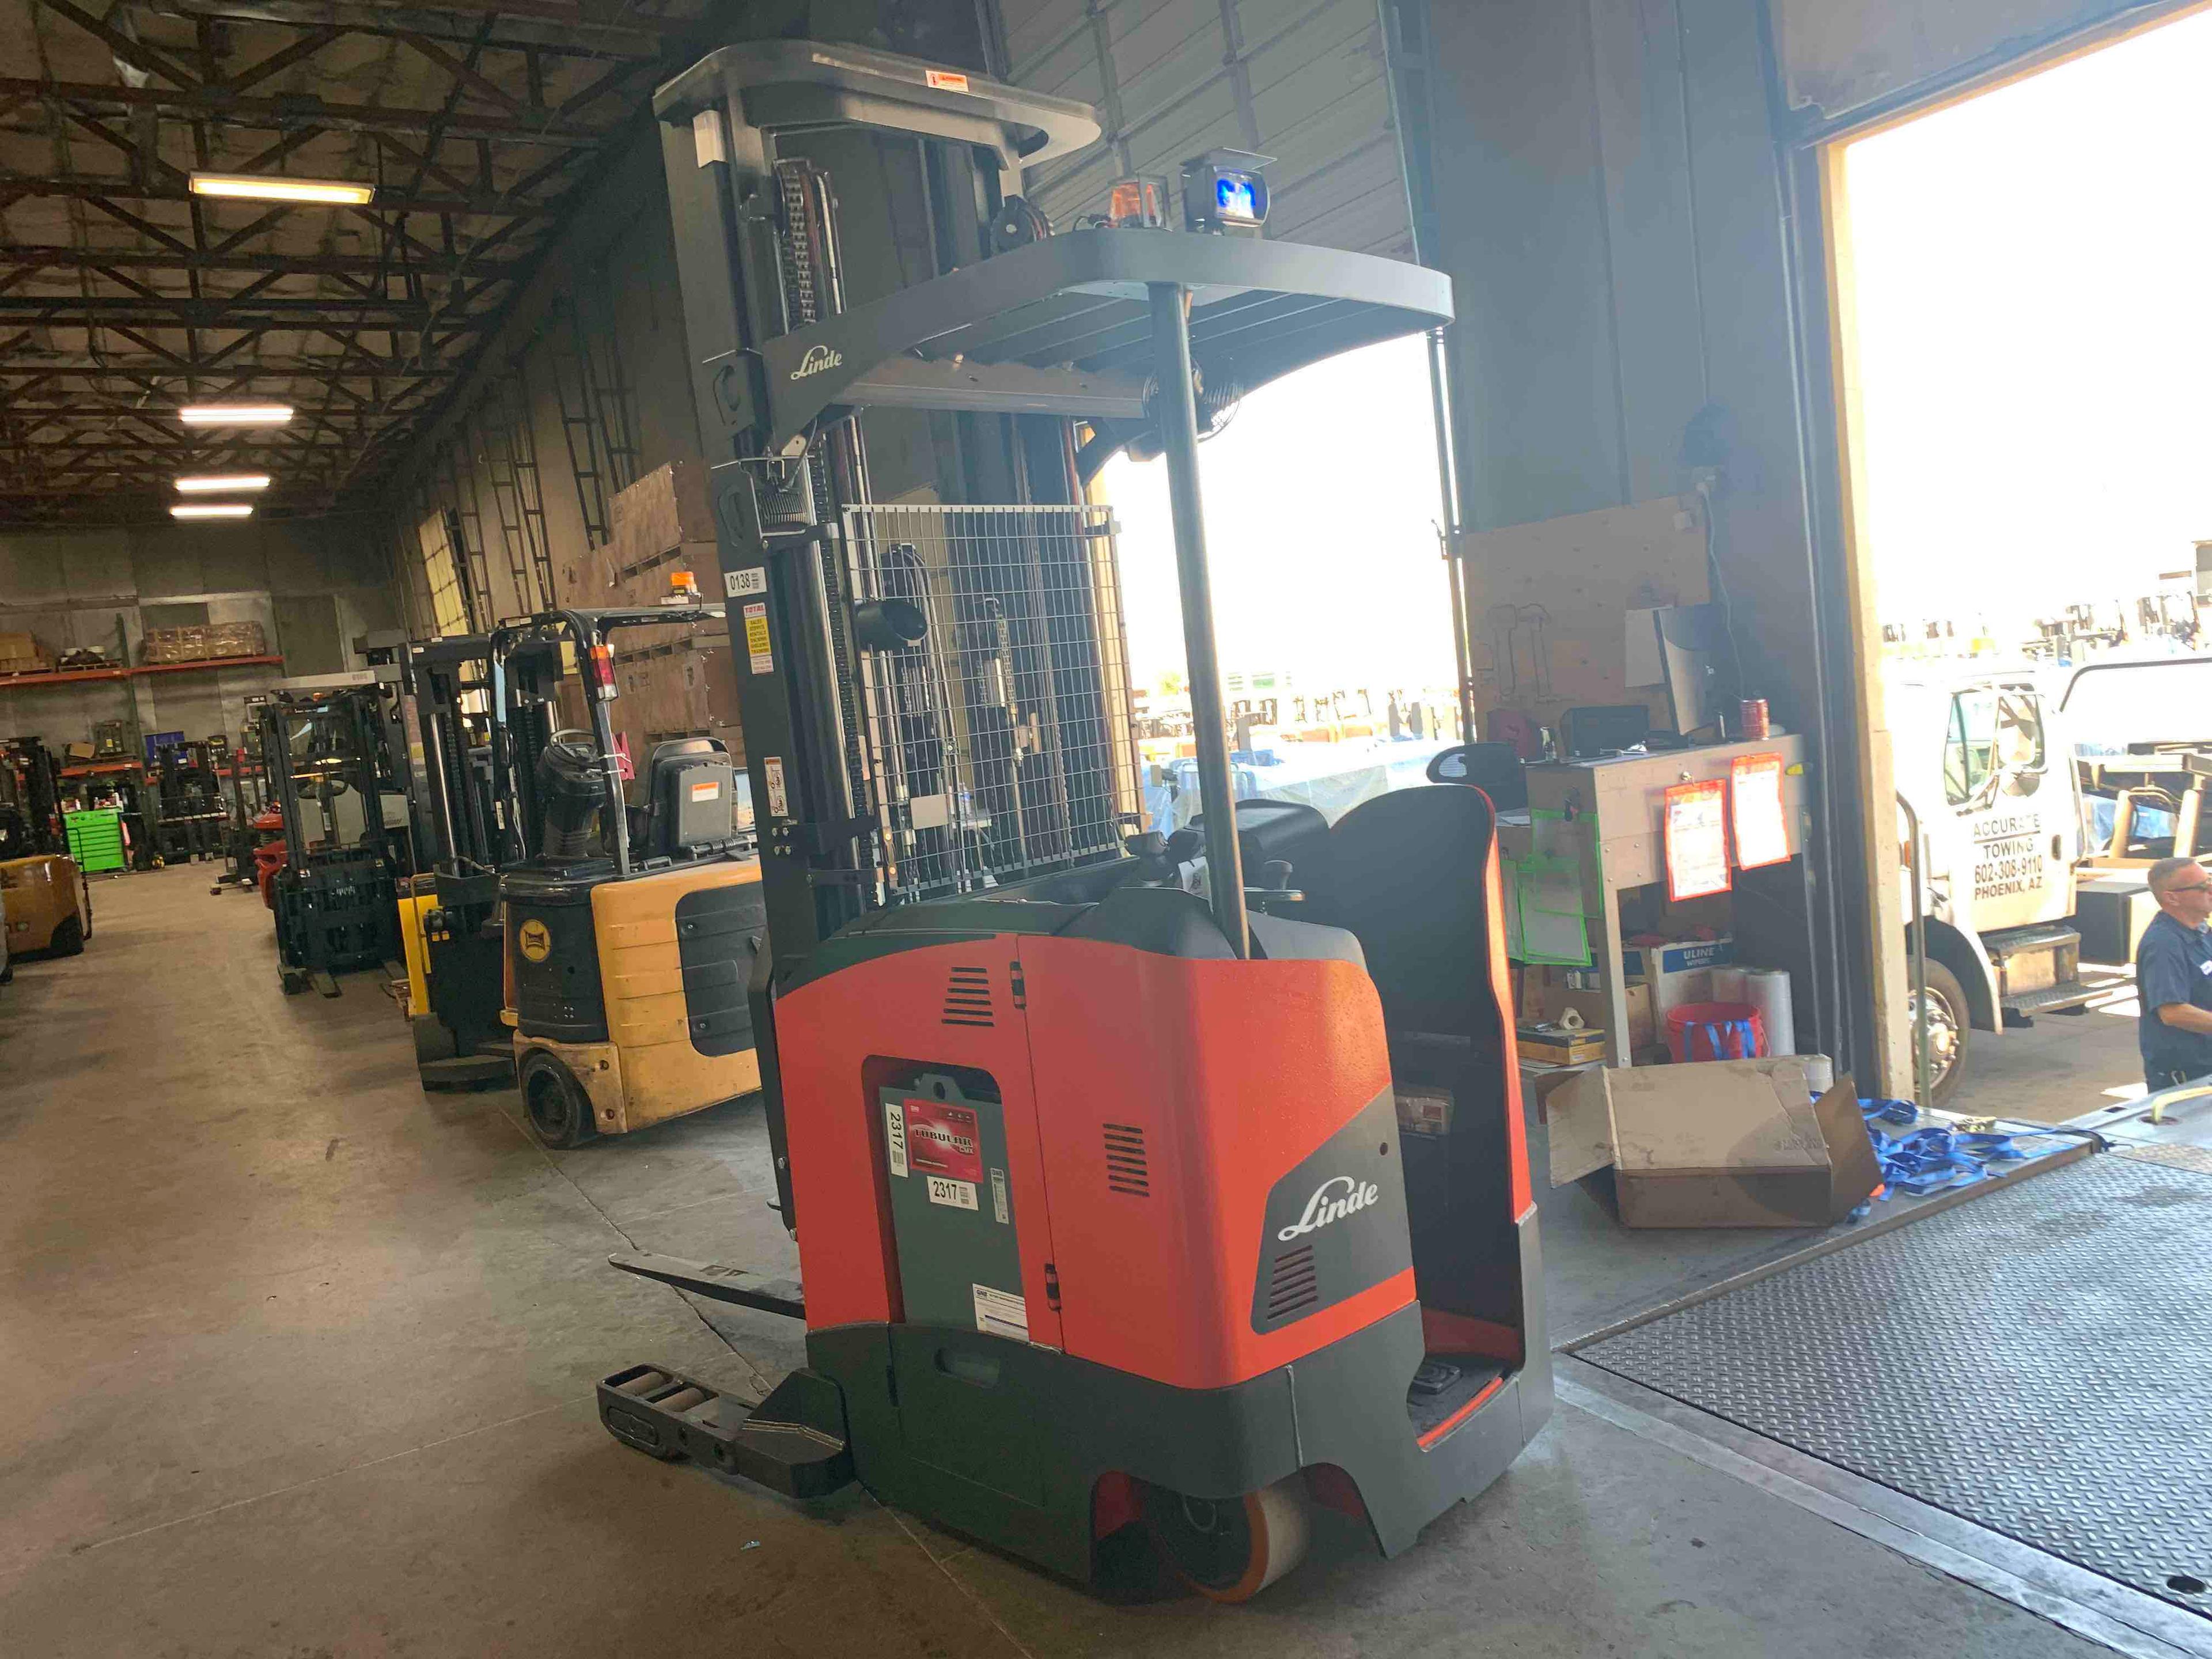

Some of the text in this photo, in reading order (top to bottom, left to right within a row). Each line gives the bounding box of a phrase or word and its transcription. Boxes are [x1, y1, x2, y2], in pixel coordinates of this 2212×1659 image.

[790, 345, 843, 381] Linde
[730, 573, 751, 590] 0138
[745, 605, 764, 613] TOTAL
[1974, 814, 2041, 836] ACCURE
[1983, 838, 2033, 859] TOWING
[1975, 855, 2042, 884] 602-308-9110
[1975, 876, 2043, 900] PHOENIX, AZ
[1683, 948, 1715, 960] ULINE
[890, 1112, 903, 1149] 2317
[933, 1180, 957, 1200] 2317
[1278, 1176, 1379, 1241] Linde
